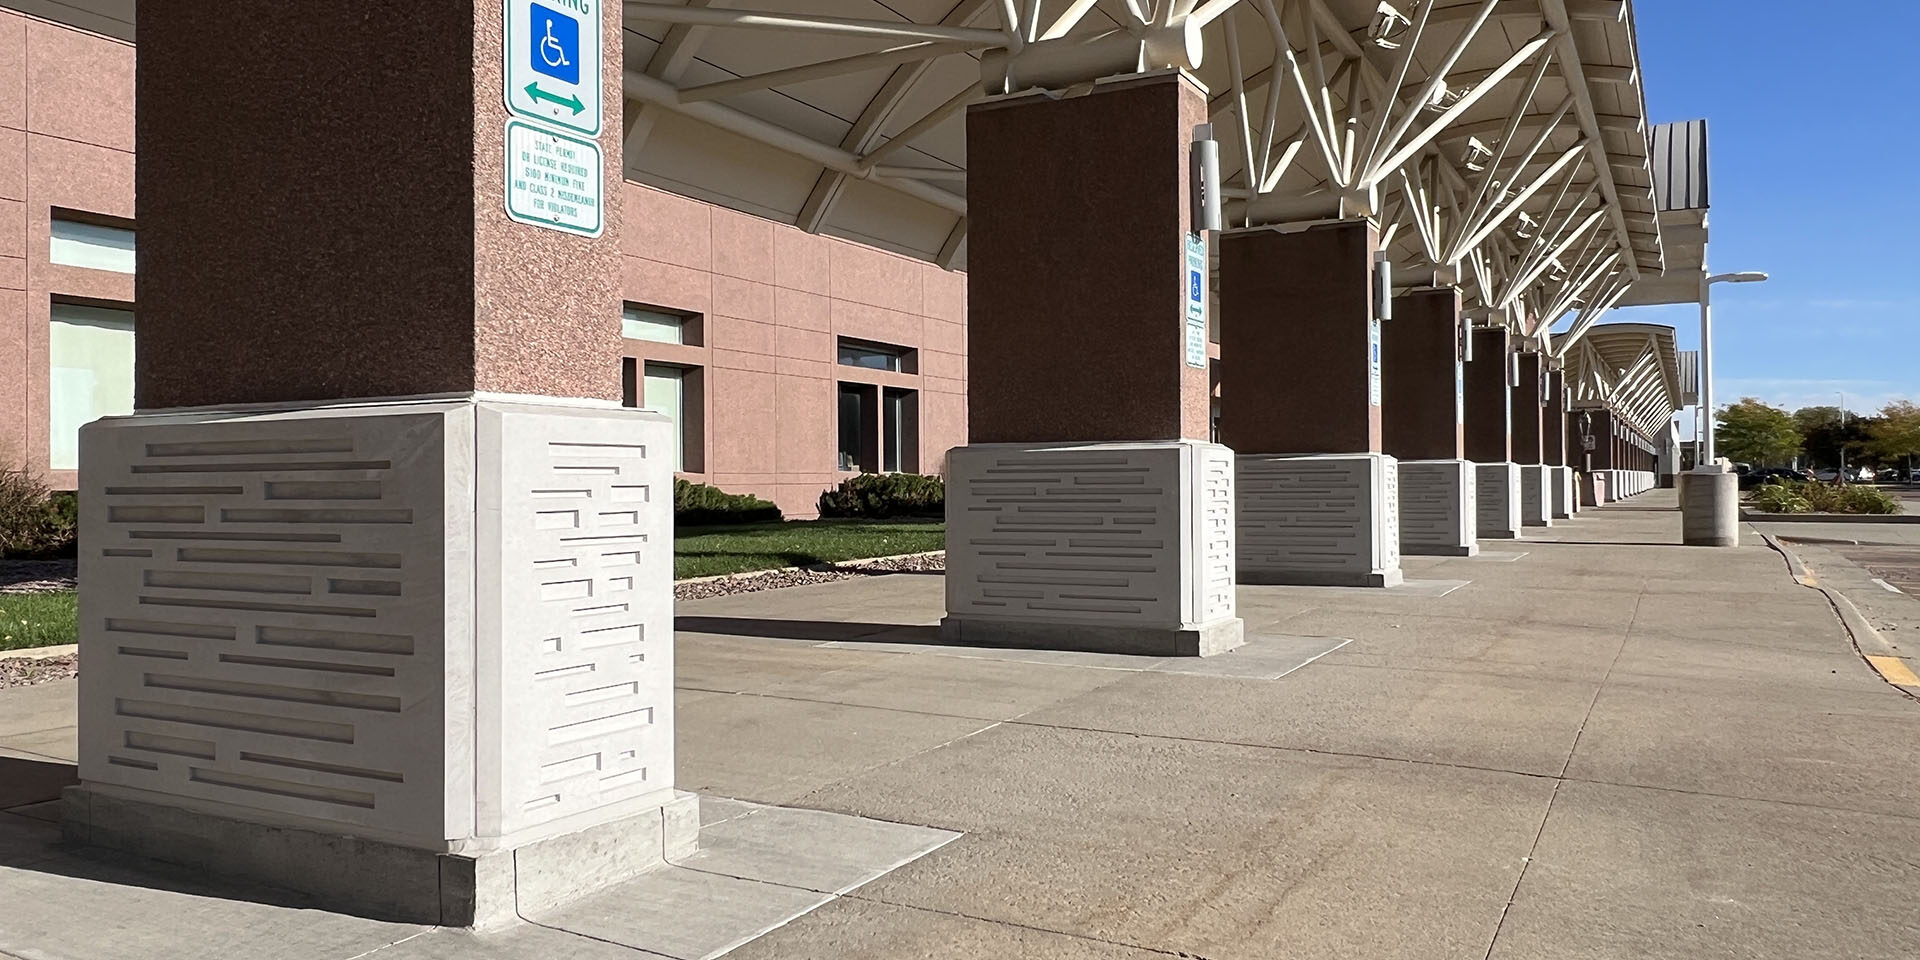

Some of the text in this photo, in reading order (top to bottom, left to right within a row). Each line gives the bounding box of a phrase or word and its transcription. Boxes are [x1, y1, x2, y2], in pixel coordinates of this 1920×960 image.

[535, 140, 552, 154] STATE
[521, 151, 588, 178] OR LICENSE REQUIRED
[544, 172, 569, 186] MINIMUM
[573, 179, 585, 191] FINE
[515, 179, 595, 207] AND CLASS 2 MISDEMEANOR
[533, 198, 578, 218] FOR VIOLATORS
